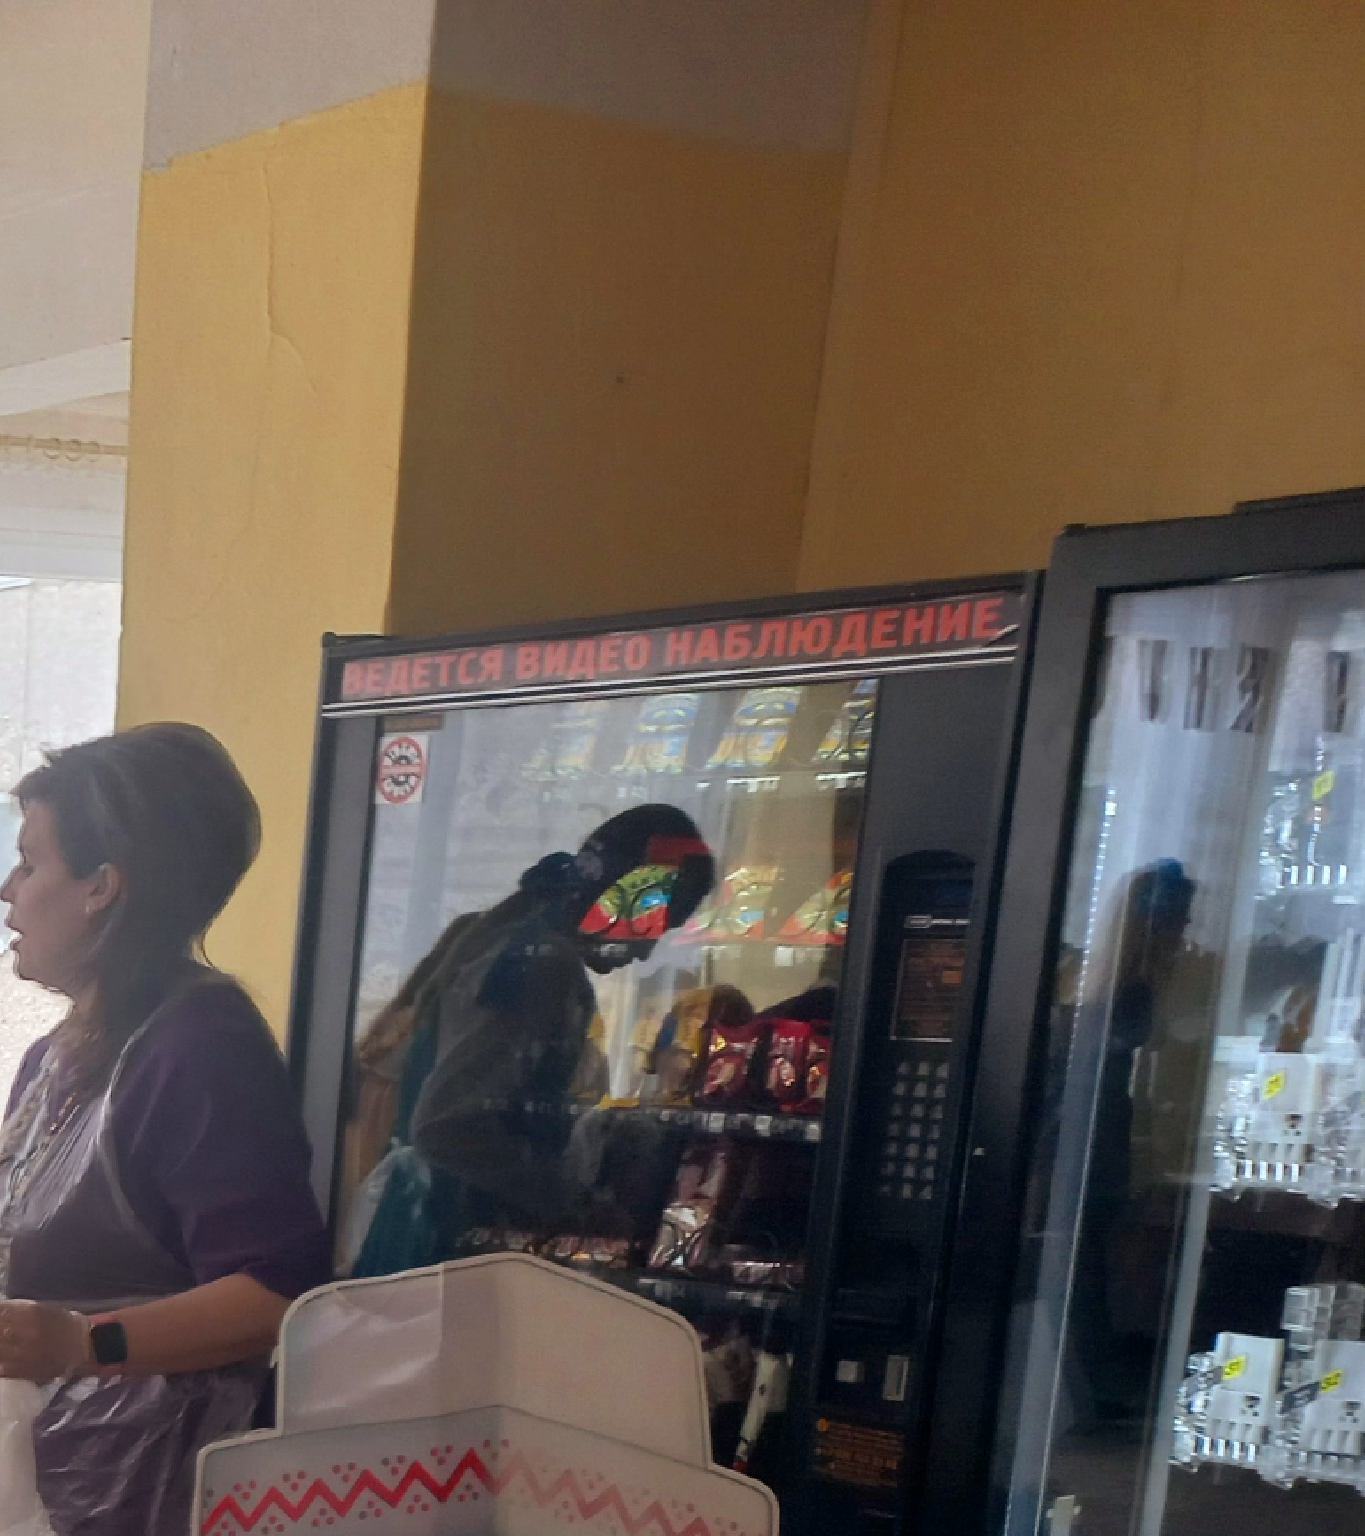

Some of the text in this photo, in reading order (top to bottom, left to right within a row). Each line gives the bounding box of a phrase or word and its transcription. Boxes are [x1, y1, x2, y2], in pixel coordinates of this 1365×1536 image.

[343, 597, 1004, 694] ВЕДЕТСЯ ВИДЕО НАБЛЮДЕНИЕ
